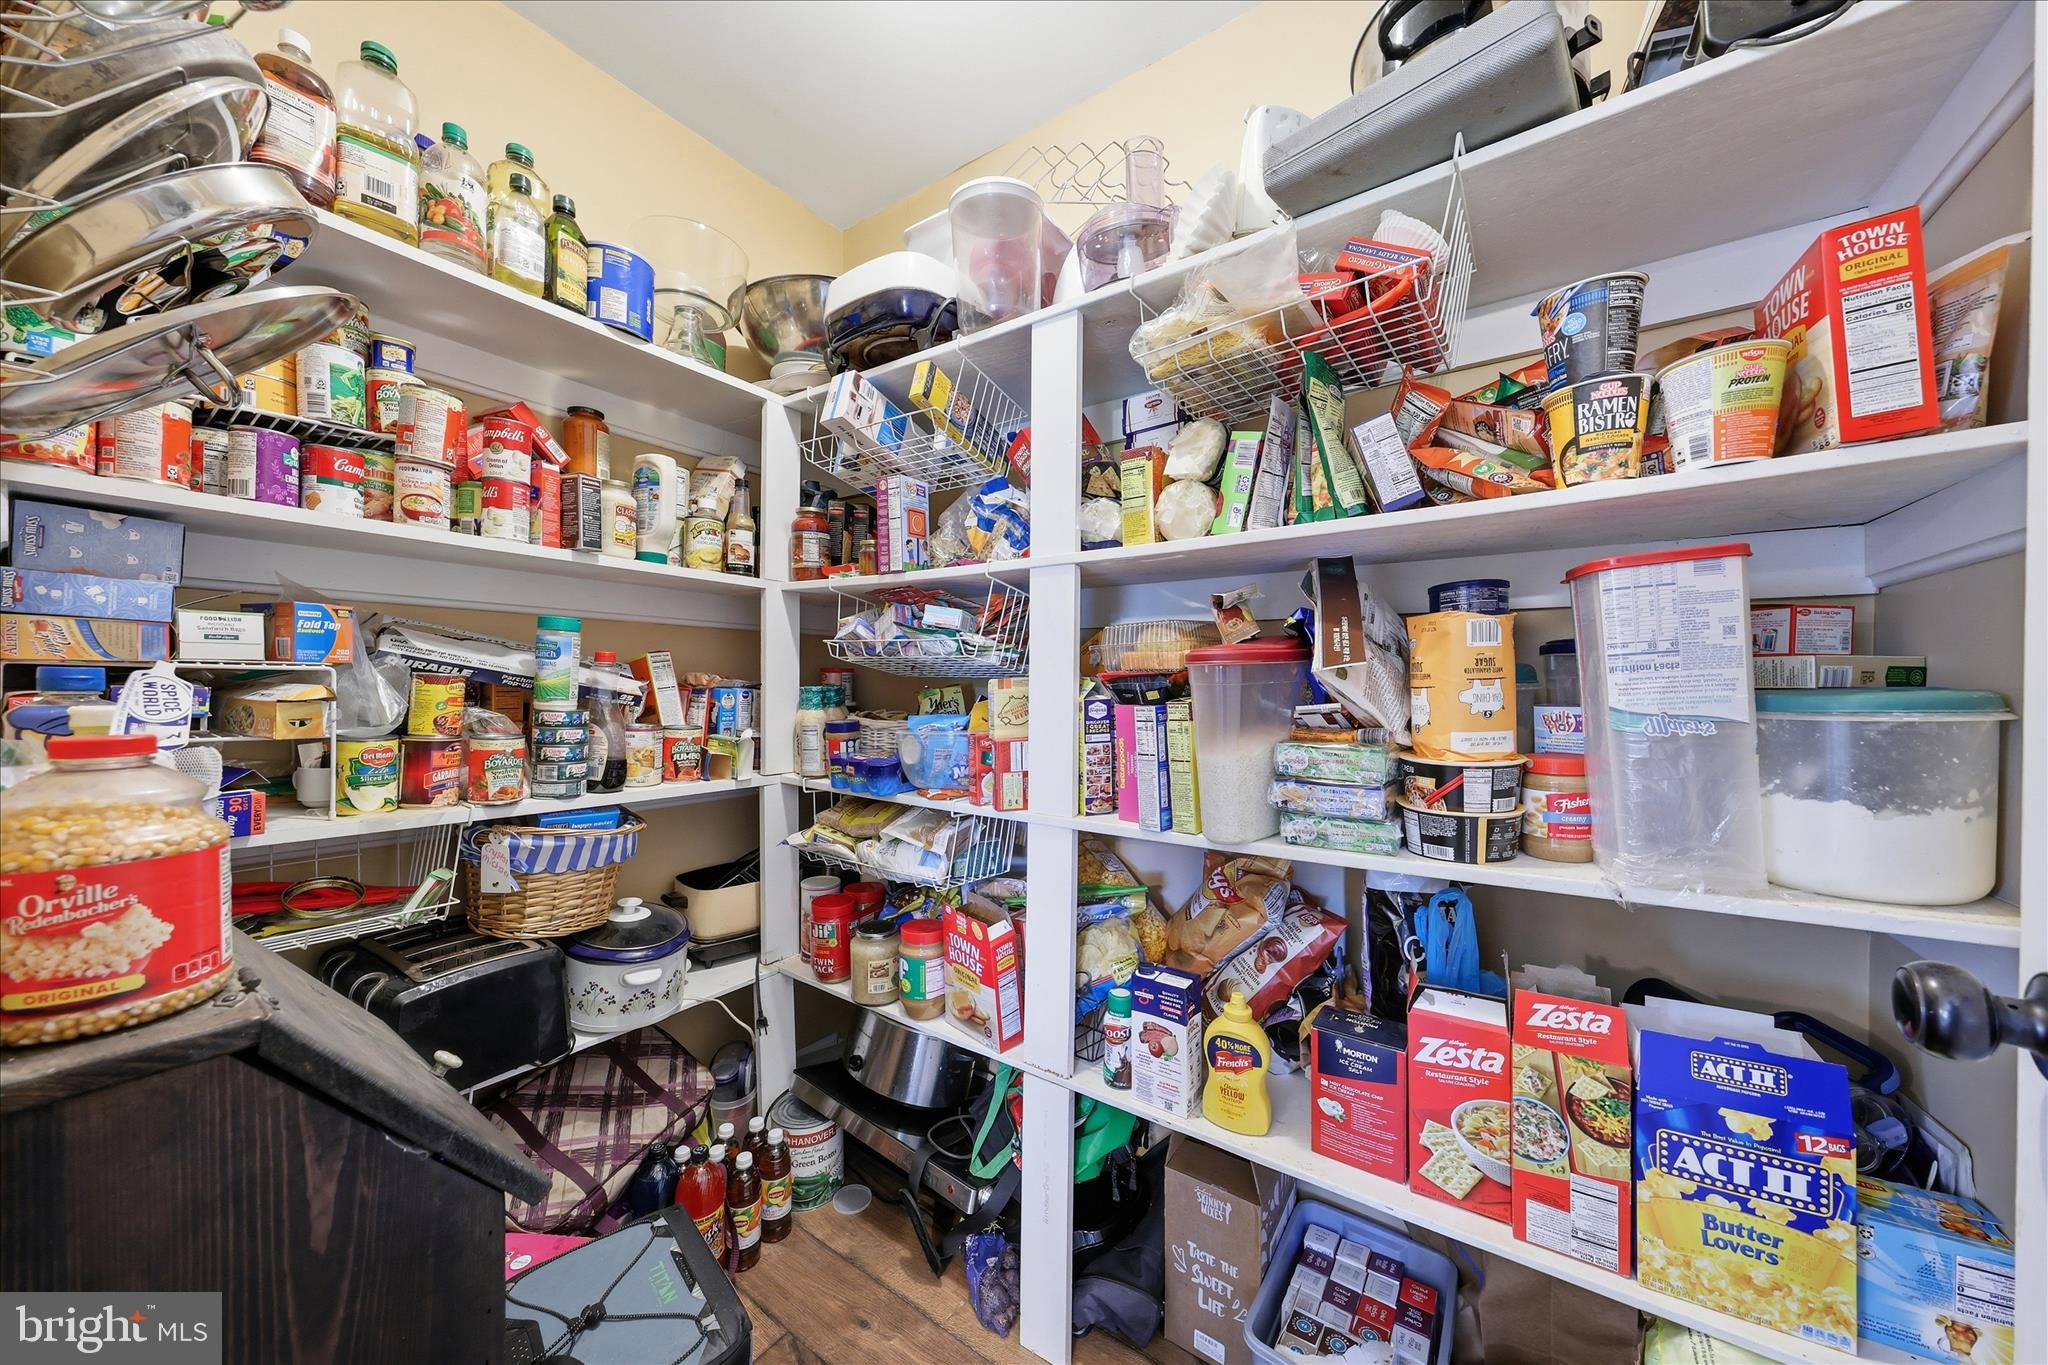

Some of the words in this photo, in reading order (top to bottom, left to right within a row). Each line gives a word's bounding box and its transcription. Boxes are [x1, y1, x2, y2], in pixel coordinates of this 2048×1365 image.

[1837, 221, 1906, 249] TOWN
[1836, 234, 1909, 263] HOUSE
[1844, 252, 1904, 273] ORIGINAL
[1763, 264, 1807, 326] TOWN
[1843, 290, 1884, 304] Nutrition
[1886, 282, 1912, 294] Facts
[1764, 292, 1810, 340] HOUSE
[1846, 308, 1888, 323] Calories
[1895, 301, 1913, 312] 80
[1728, 374, 1772, 389] PROTEIN
[1578, 396, 1638, 420] RAMEN
[1578, 412, 1637, 435] BISTRO
[297, 620, 321, 629] Fold
[324, 621, 341, 631] Top
[1411, 661, 1423, 672] SUGA
[1474, 657, 1496, 667] SUGAR
[502, 674, 535, 685] Parchm
[143, 682, 162, 717] WORLD
[160, 684, 182, 713] SPICE
[672, 752, 701, 761] JUMBO
[229, 798, 243, 813] 90
[253, 798, 262, 831] EVERYDAY
[1554, 798, 1591, 815] Fisher
[18, 883, 119, 918] Orville
[7, 893, 139, 936] Redenbacher's
[812, 924, 833, 939] Jif
[948, 932, 982, 961] TOWN
[813, 958, 835, 967] TWIN
[814, 966, 835, 975] PACK
[948, 946, 985, 977] HOUSE
[23, 982, 121, 1006] ORIGINAL
[1526, 1003, 1613, 1035] Zesta
[1104, 1027, 1131, 1039] OOST
[1536, 1032, 1578, 1043] Restaurant
[1578, 1037, 1598, 1046] Style
[1215, 1037, 1234, 1050] 40%
[1234, 1043, 1252, 1053] MORE
[1342, 1047, 1379, 1064] MORTON
[1412, 1036, 1506, 1075] Zesta
[1216, 1056, 1249, 1068] French's
[1338, 1058, 1350, 1067] ICE
[1350, 1062, 1373, 1073] CREAM
[1425, 1068, 1468, 1083] Restaurant
[1468, 1076, 1490, 1087] Style
[1700, 1060, 1746, 1082] ACT
[1749, 1070, 1776, 1088] II
[1220, 1086, 1245, 1101] YELLOW
[790, 1128, 837, 1146] HANOVER
[1700, 1130, 1712, 1138] The
[1726, 1136, 1745, 1146] Value
[1798, 1135, 1829, 1155] 12
[1828, 1142, 1847, 1154] BAGS
[791, 1156, 816, 1169] Green
[818, 1150, 838, 1164] Beans
[1673, 1146, 1755, 1189] ACT
[1762, 1166, 1812, 1203] II
[1196, 1190, 1224, 1211] SKINNY
[1201, 1203, 1224, 1222] MIXES
[1702, 1212, 1785, 1250] Butter
[1700, 1229, 1782, 1267] Lovers
[1186, 1240, 1216, 1267] TASTE
[1220, 1260, 1239, 1279] THE
[1191, 1264, 1234, 1300] SWEET
[1198, 1287, 1225, 1318] LIFE
